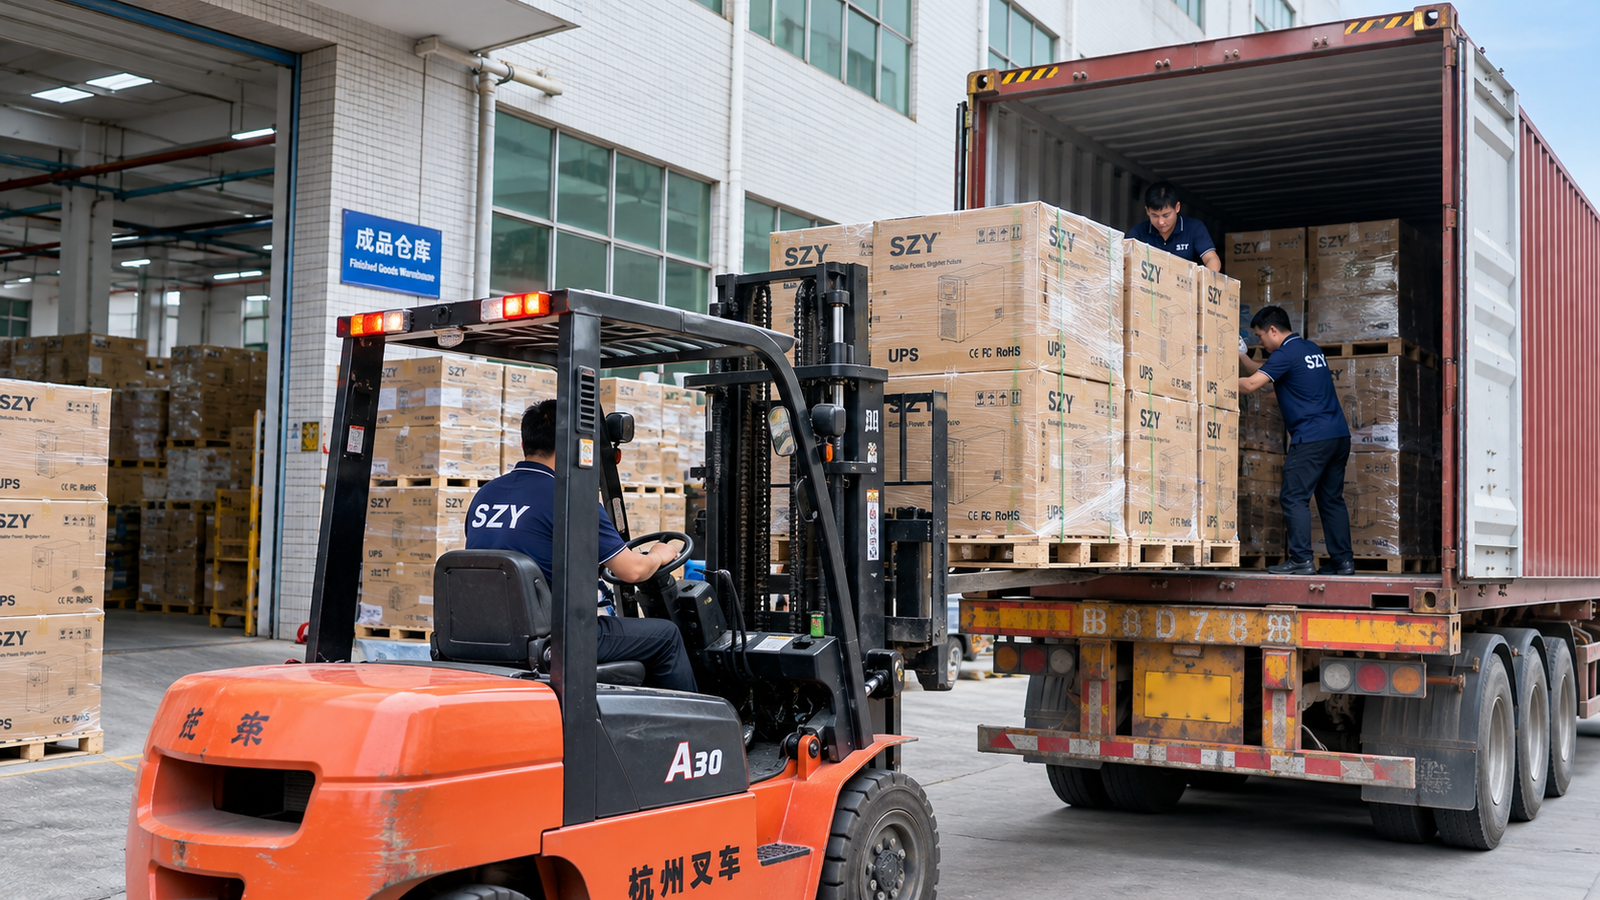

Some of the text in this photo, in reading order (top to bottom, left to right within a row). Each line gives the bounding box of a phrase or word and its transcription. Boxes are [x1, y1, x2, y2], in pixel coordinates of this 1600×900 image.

[355, 227, 432, 263] 成品仓库
[890, 232, 938, 257] SZY
[1234, 241, 1260, 255] SZY
[1318, 235, 1348, 249] SZY
[784, 243, 829, 267] SZY
[1141, 260, 1162, 284] SZY
[1207, 285, 1222, 306] SZY
[888, 347, 919, 363] UPS
[996, 346, 1021, 357] RoHS
[1047, 340, 1066, 359] UPS
[1304, 353, 1327, 369] SZY
[448, 366, 467, 377] SZY
[1140, 364, 1153, 381] UPS
[0, 394, 35, 411] SZY
[1048, 390, 1073, 414] SZY
[1140, 408, 1161, 430] SZY
[1207, 421, 1221, 440] SZY
[370, 497, 391, 508] SZY
[445, 498, 464, 508] SZY
[472, 503, 530, 529] SZY
[995, 511, 1020, 521] RoHS
[1139, 510, 1153, 525] UPS
[368, 550, 383, 558] UPS
[0, 630, 28, 647] ZY
[664, 741, 723, 784] A30
[628, 845, 741, 900] 杭州叉车
